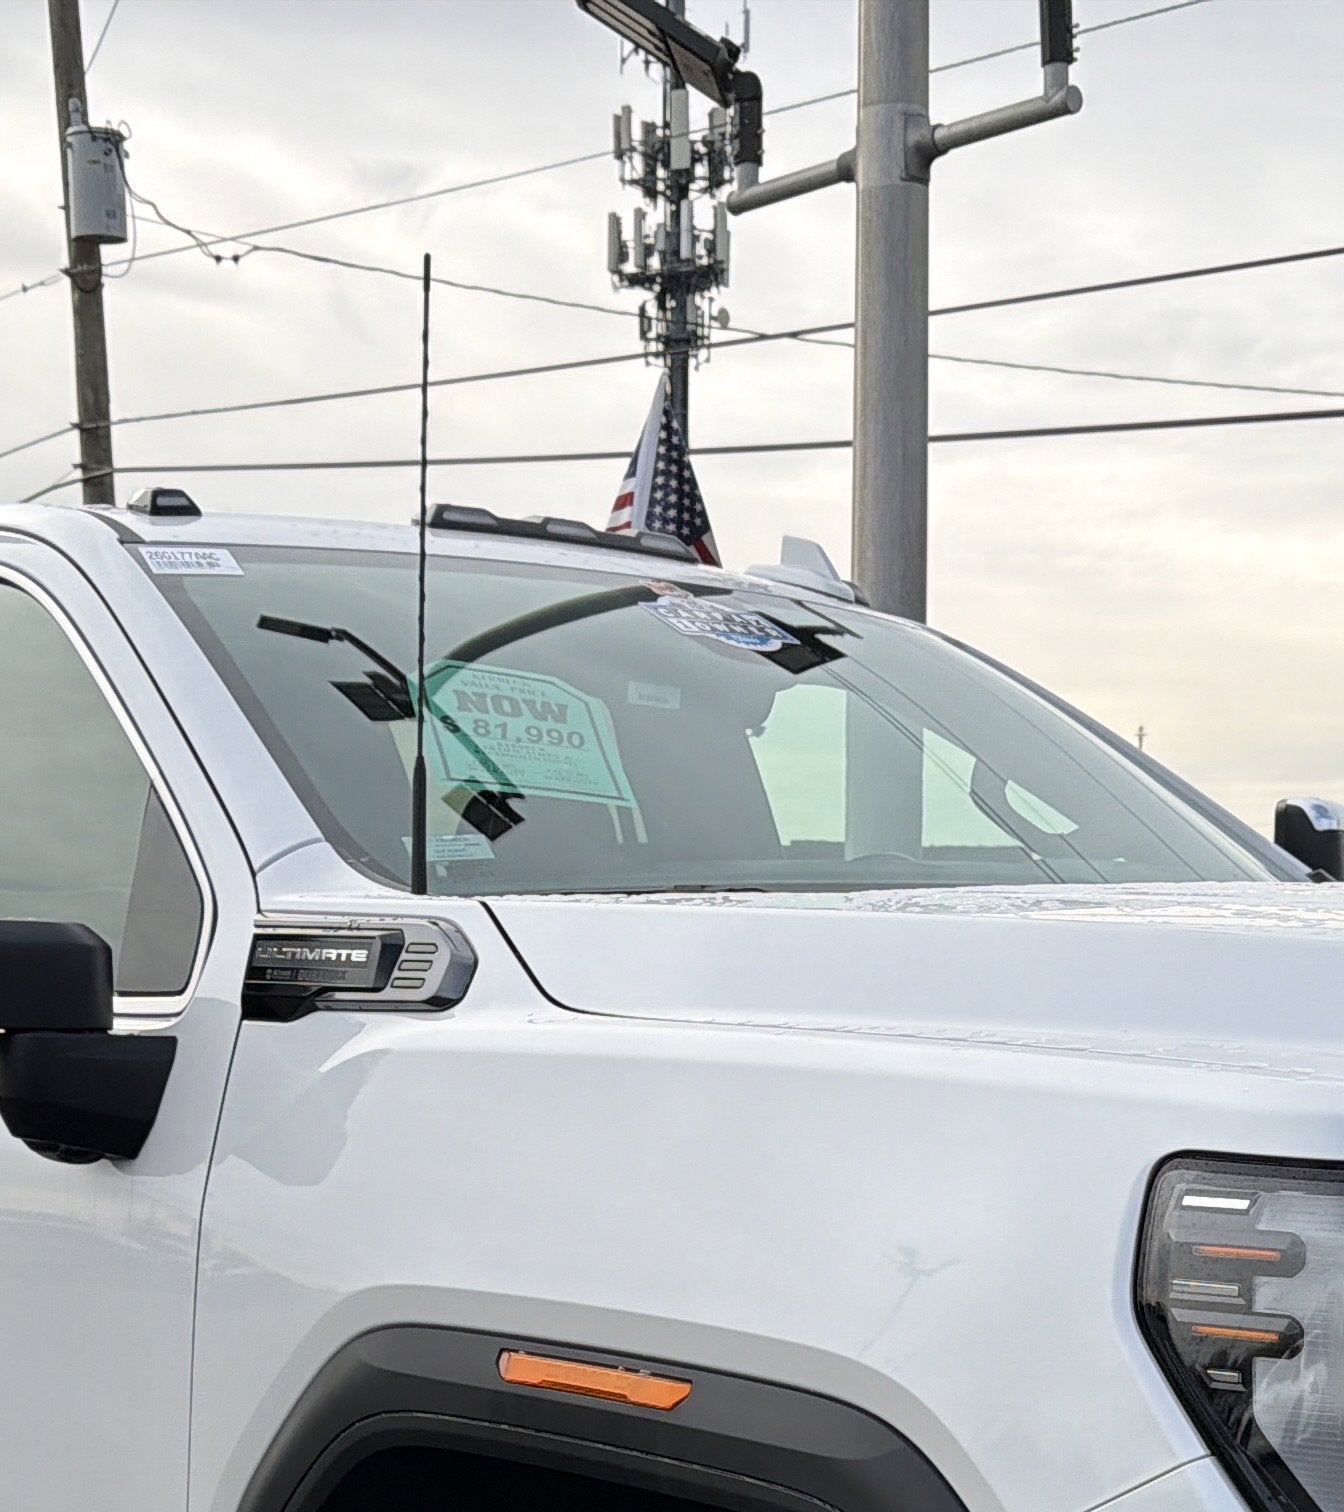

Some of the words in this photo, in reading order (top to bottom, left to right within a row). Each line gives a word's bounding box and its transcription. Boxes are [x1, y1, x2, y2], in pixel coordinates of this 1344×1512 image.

[453, 689, 568, 724] NOW
[440, 715, 460, 735] $
[472, 718, 585, 750] 81,990
[255, 941, 369, 963] ULTIMATE
